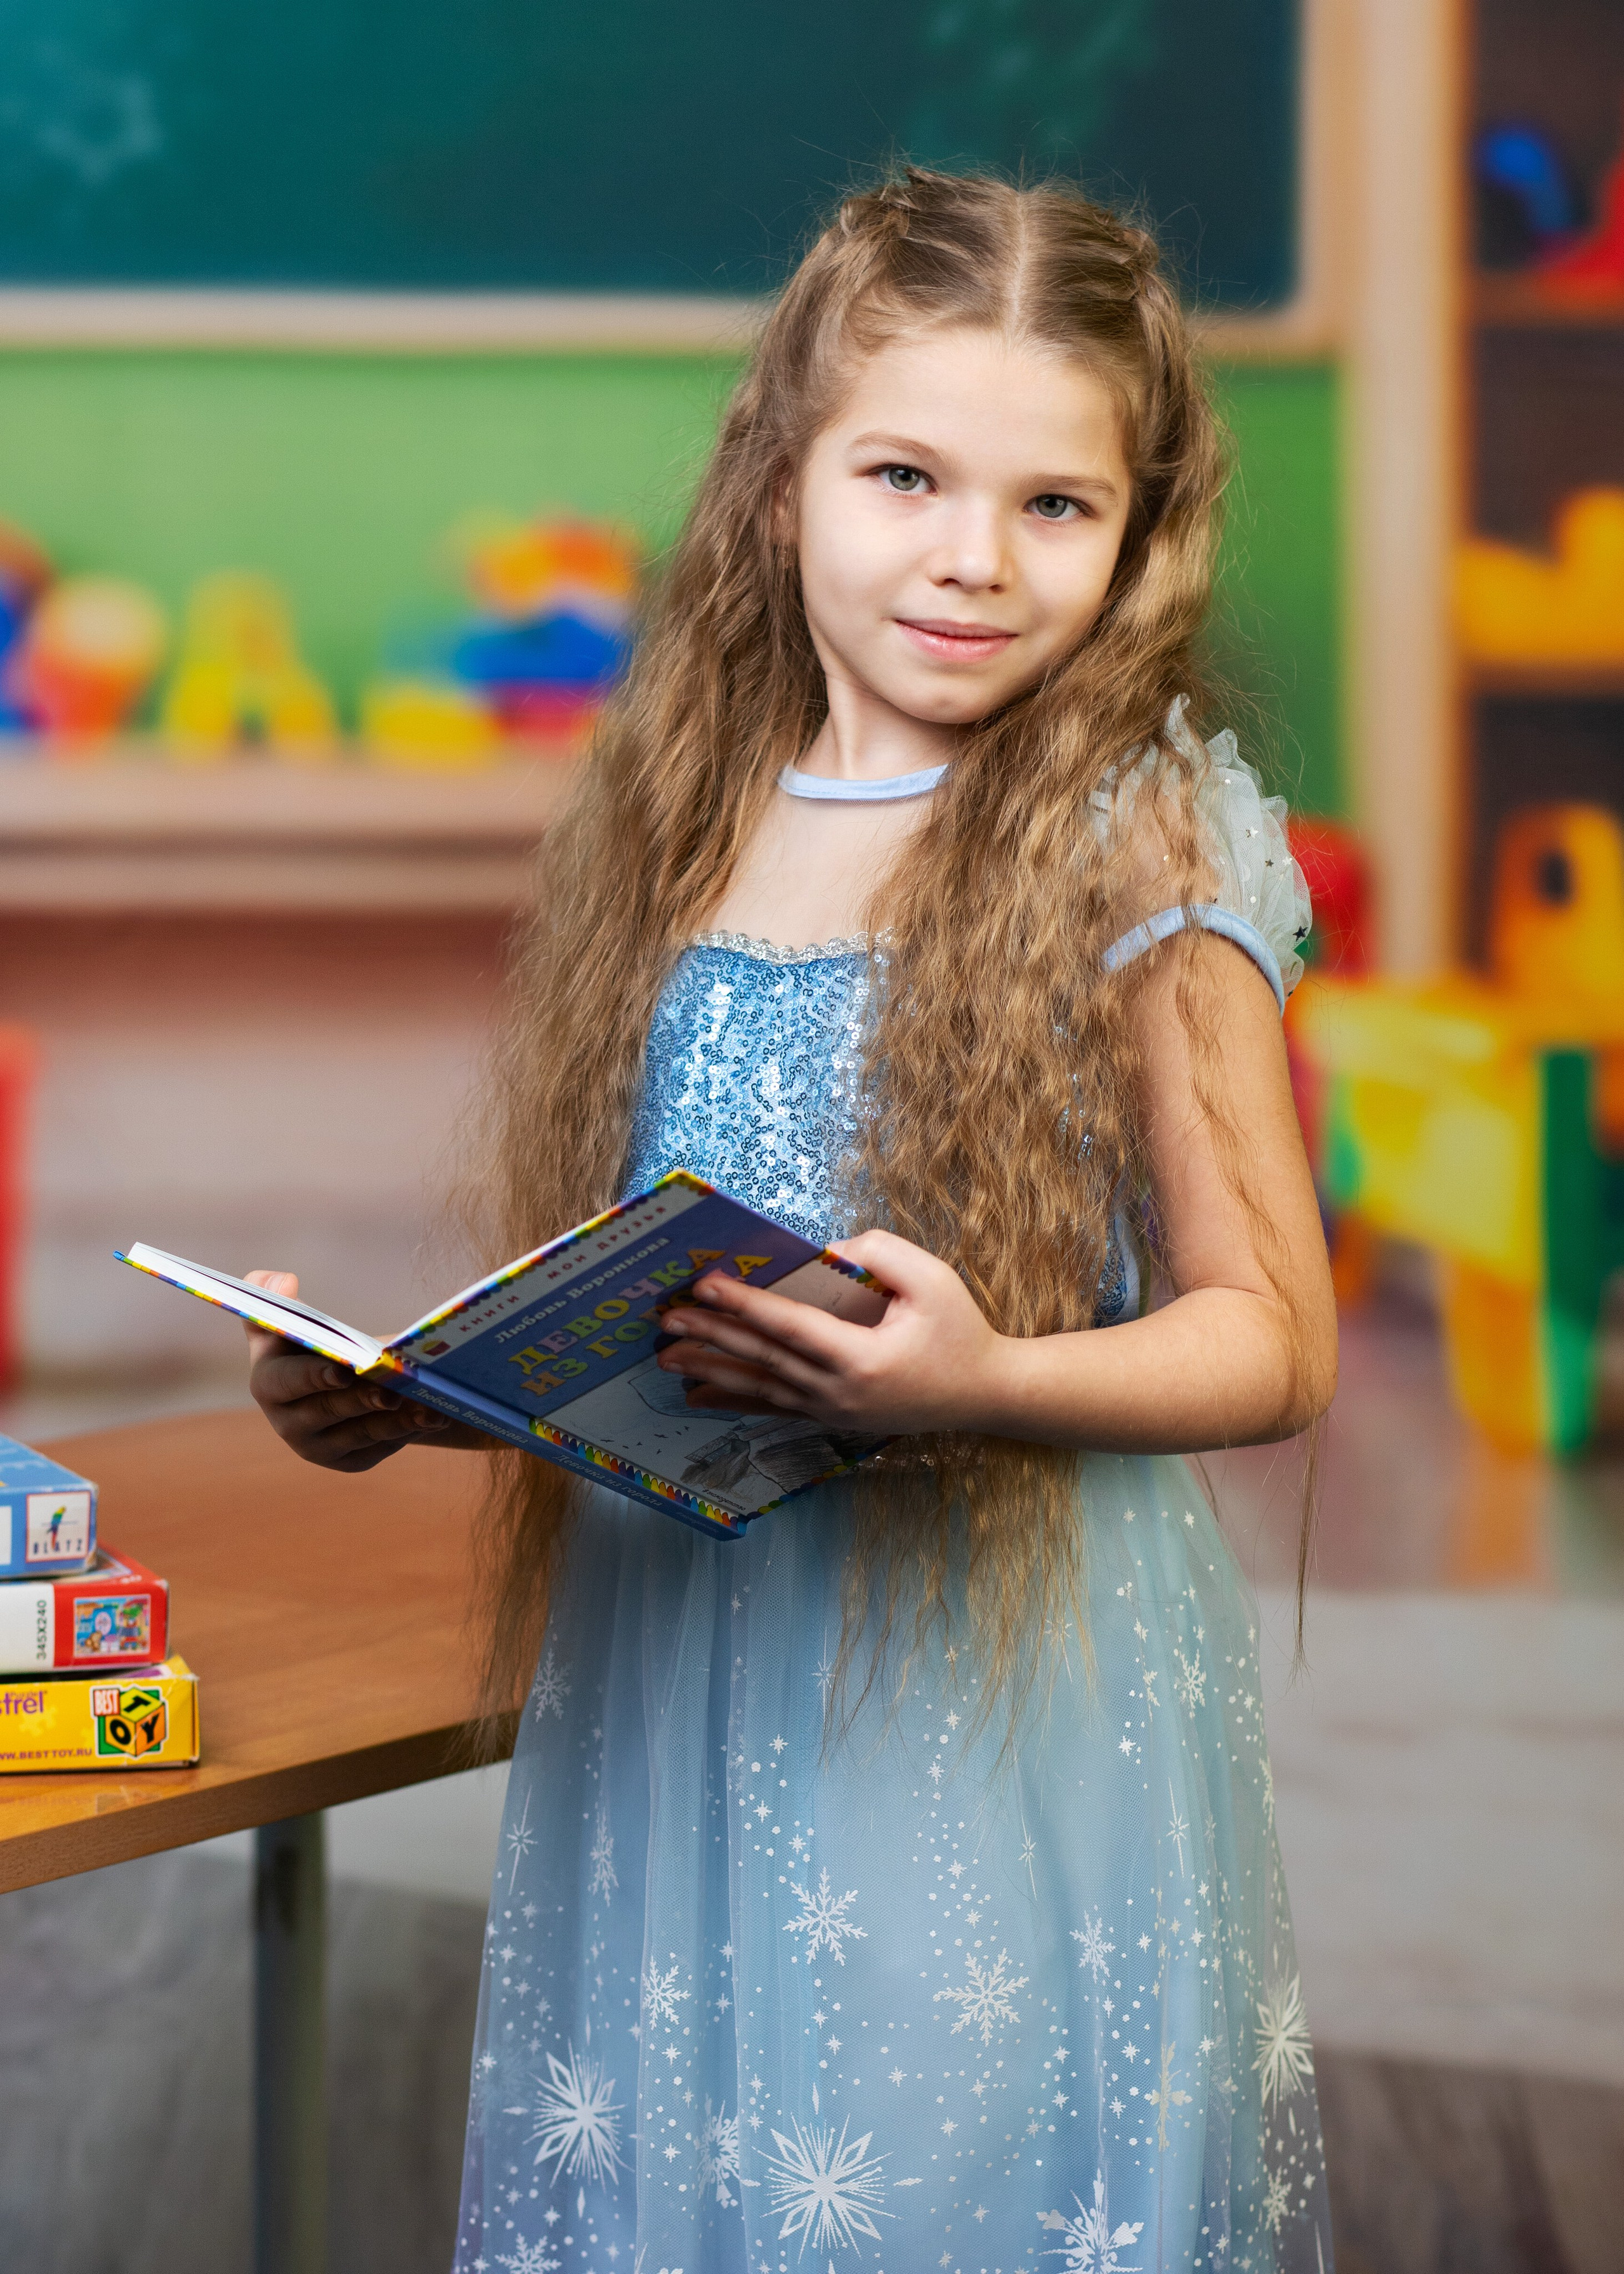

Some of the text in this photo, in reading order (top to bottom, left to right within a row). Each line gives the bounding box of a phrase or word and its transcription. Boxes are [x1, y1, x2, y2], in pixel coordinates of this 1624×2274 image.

[495, 1237, 670, 1344] Любовь Воронкова
[508, 1249, 726, 1375] ДЕВОЧКА
[520, 1357, 588, 1396] ИЗ
[412, 1388, 529, 1444] Любовь Воронкова
[551, 1454, 605, 1480] Девочка
[621, 1485, 663, 1507] города
[0, 1690, 44, 1715] trel
[94, 1690, 119, 1716] BEST
